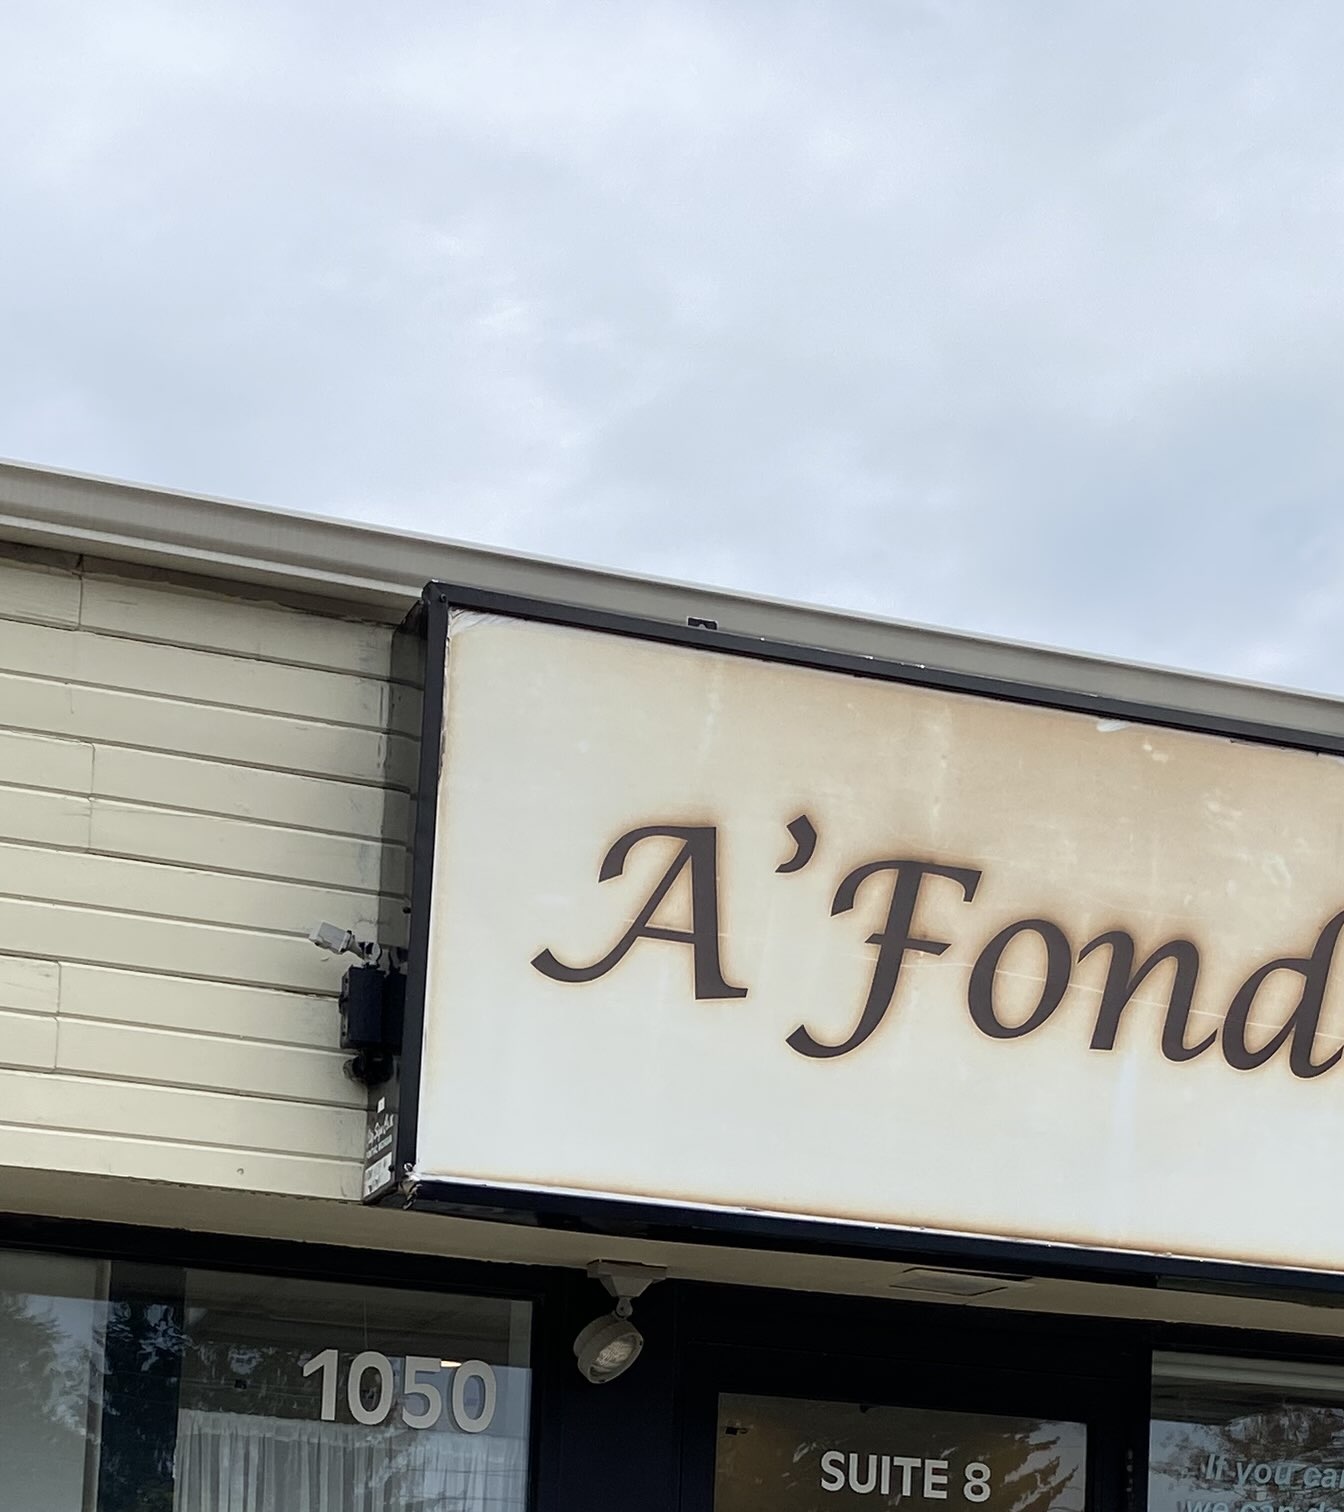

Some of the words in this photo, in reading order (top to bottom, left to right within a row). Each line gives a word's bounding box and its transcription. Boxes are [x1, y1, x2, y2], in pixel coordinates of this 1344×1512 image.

[302, 1348, 497, 1434] 1050
[819, 1451, 948, 1500] SUITE
[963, 1461, 993, 1503] 8
[1235, 1462, 1295, 1488] you
